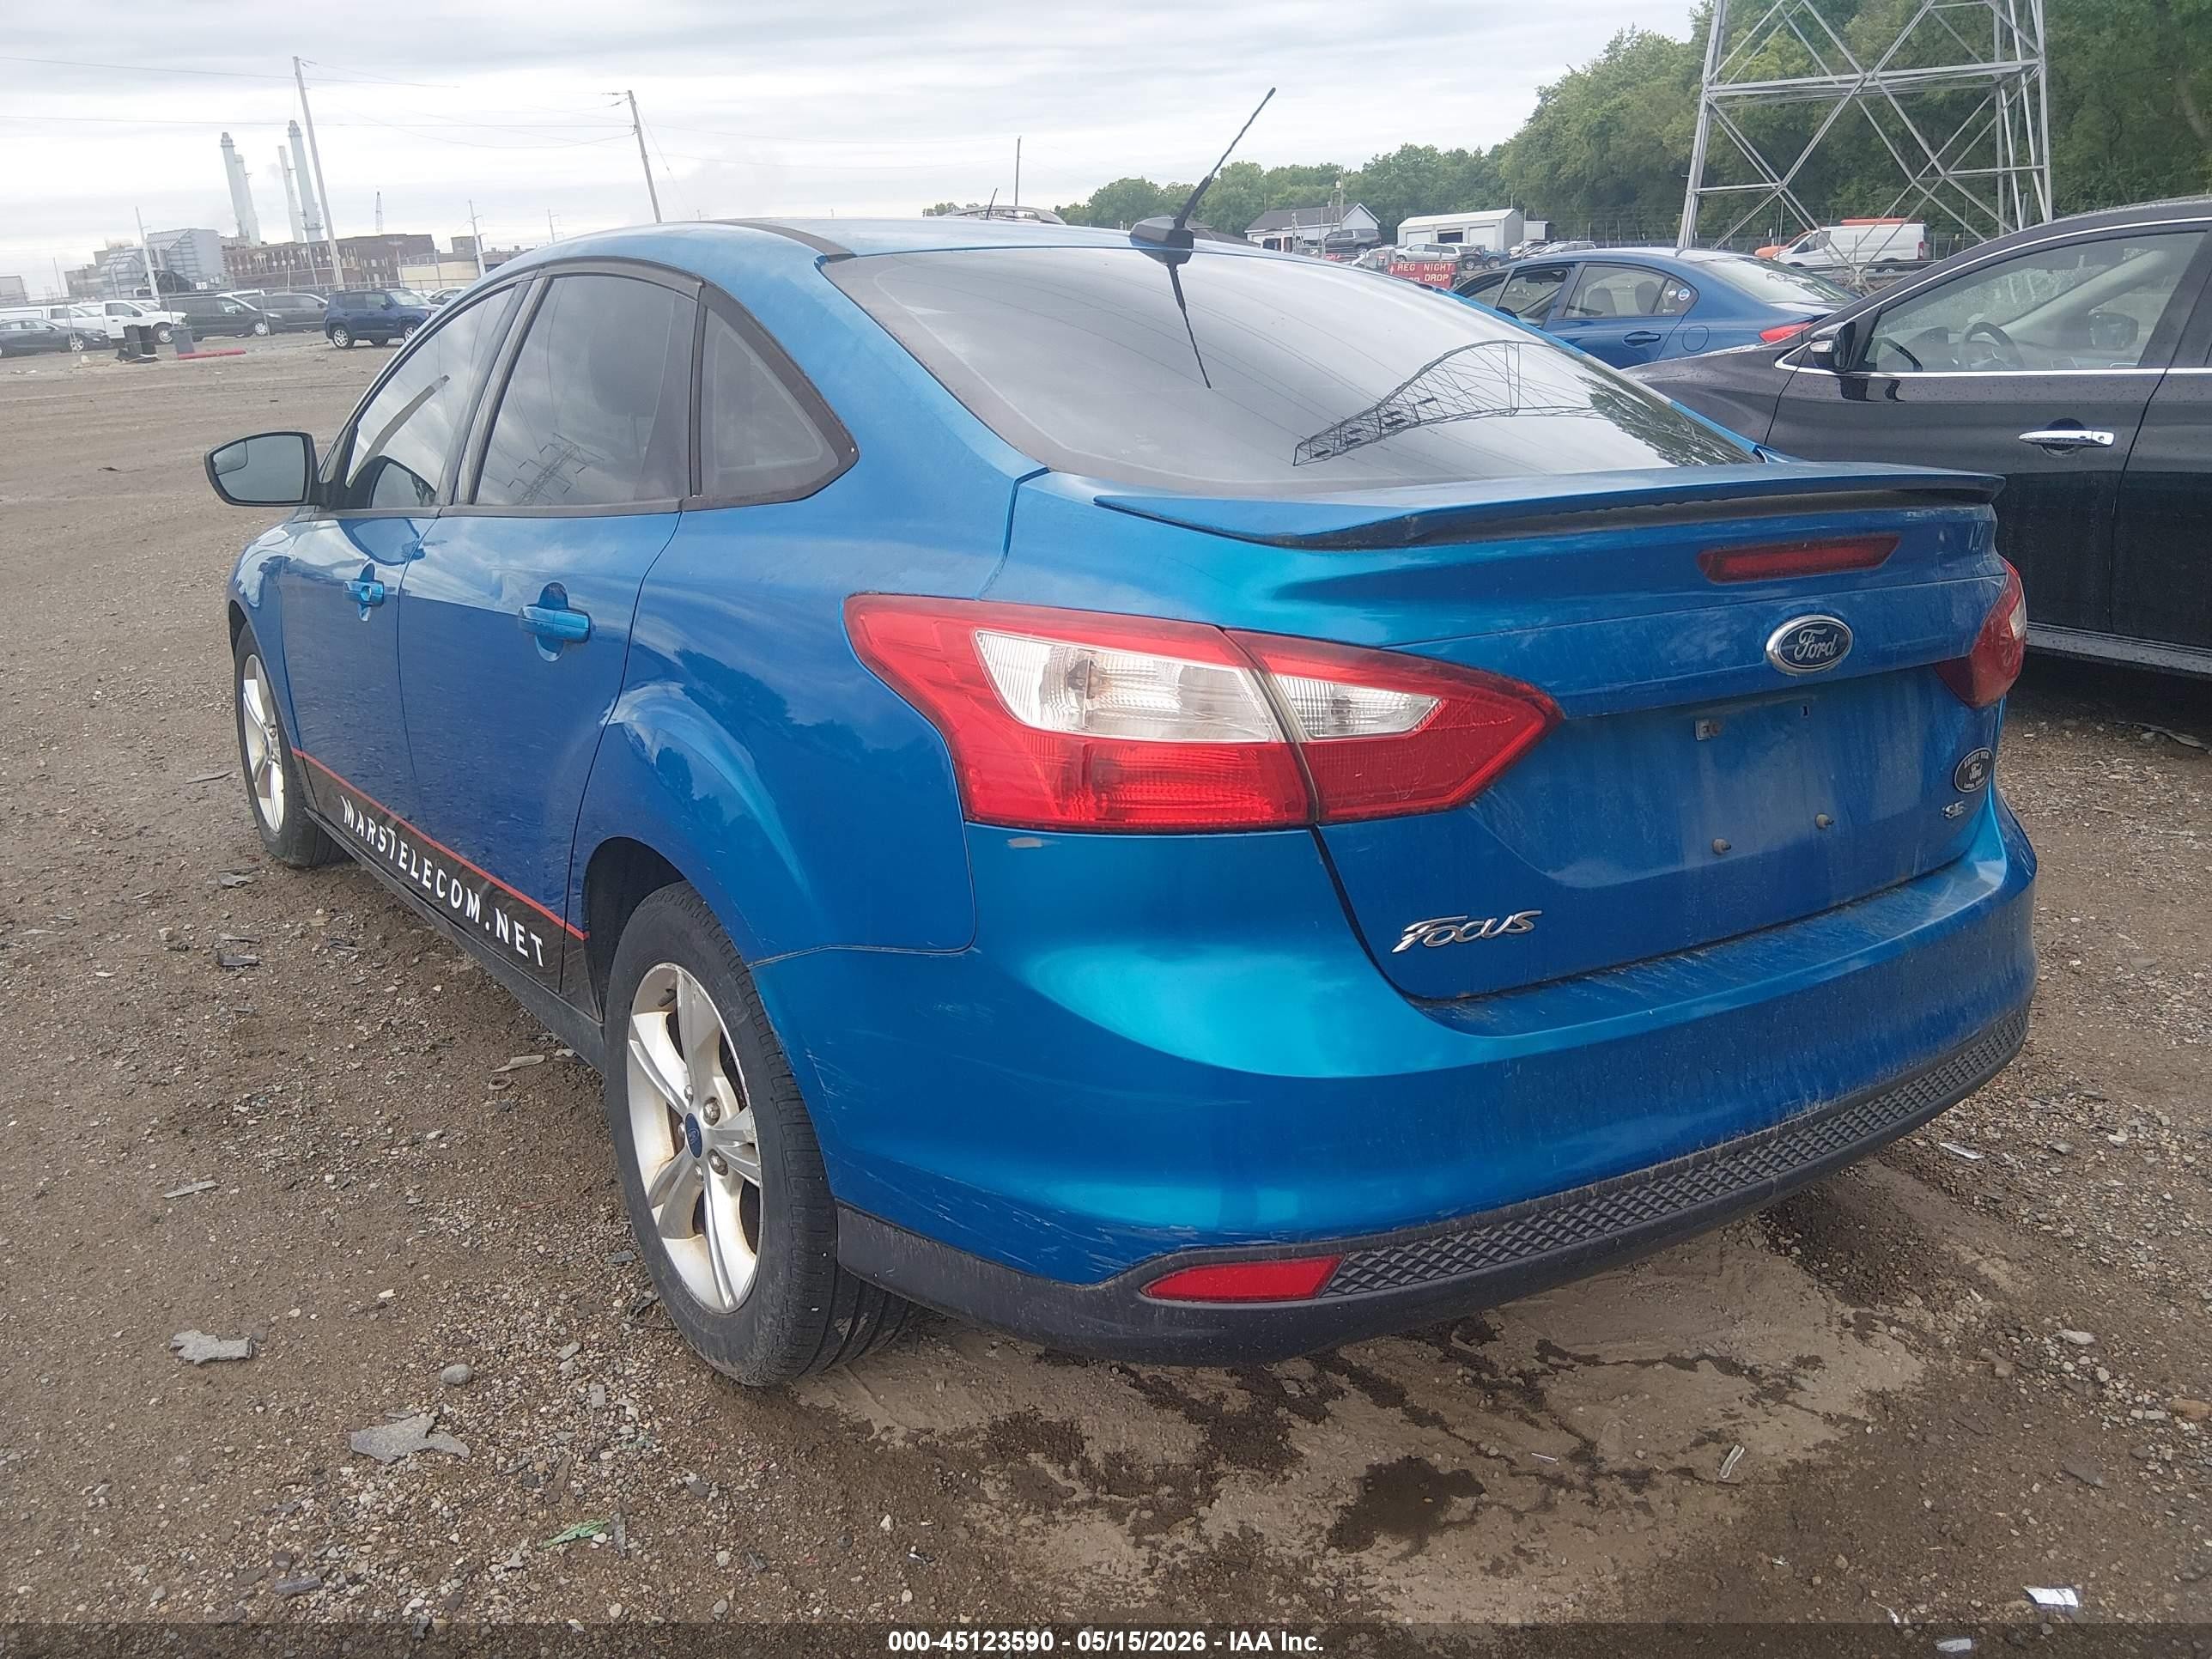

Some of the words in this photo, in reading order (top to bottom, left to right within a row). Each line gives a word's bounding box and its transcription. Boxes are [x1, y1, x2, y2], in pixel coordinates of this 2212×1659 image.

[1423, 263, 1453, 271] NIGHT
[1794, 628, 1838, 661] Ford
[340, 794, 544, 968] MARSTELECOM.NET
